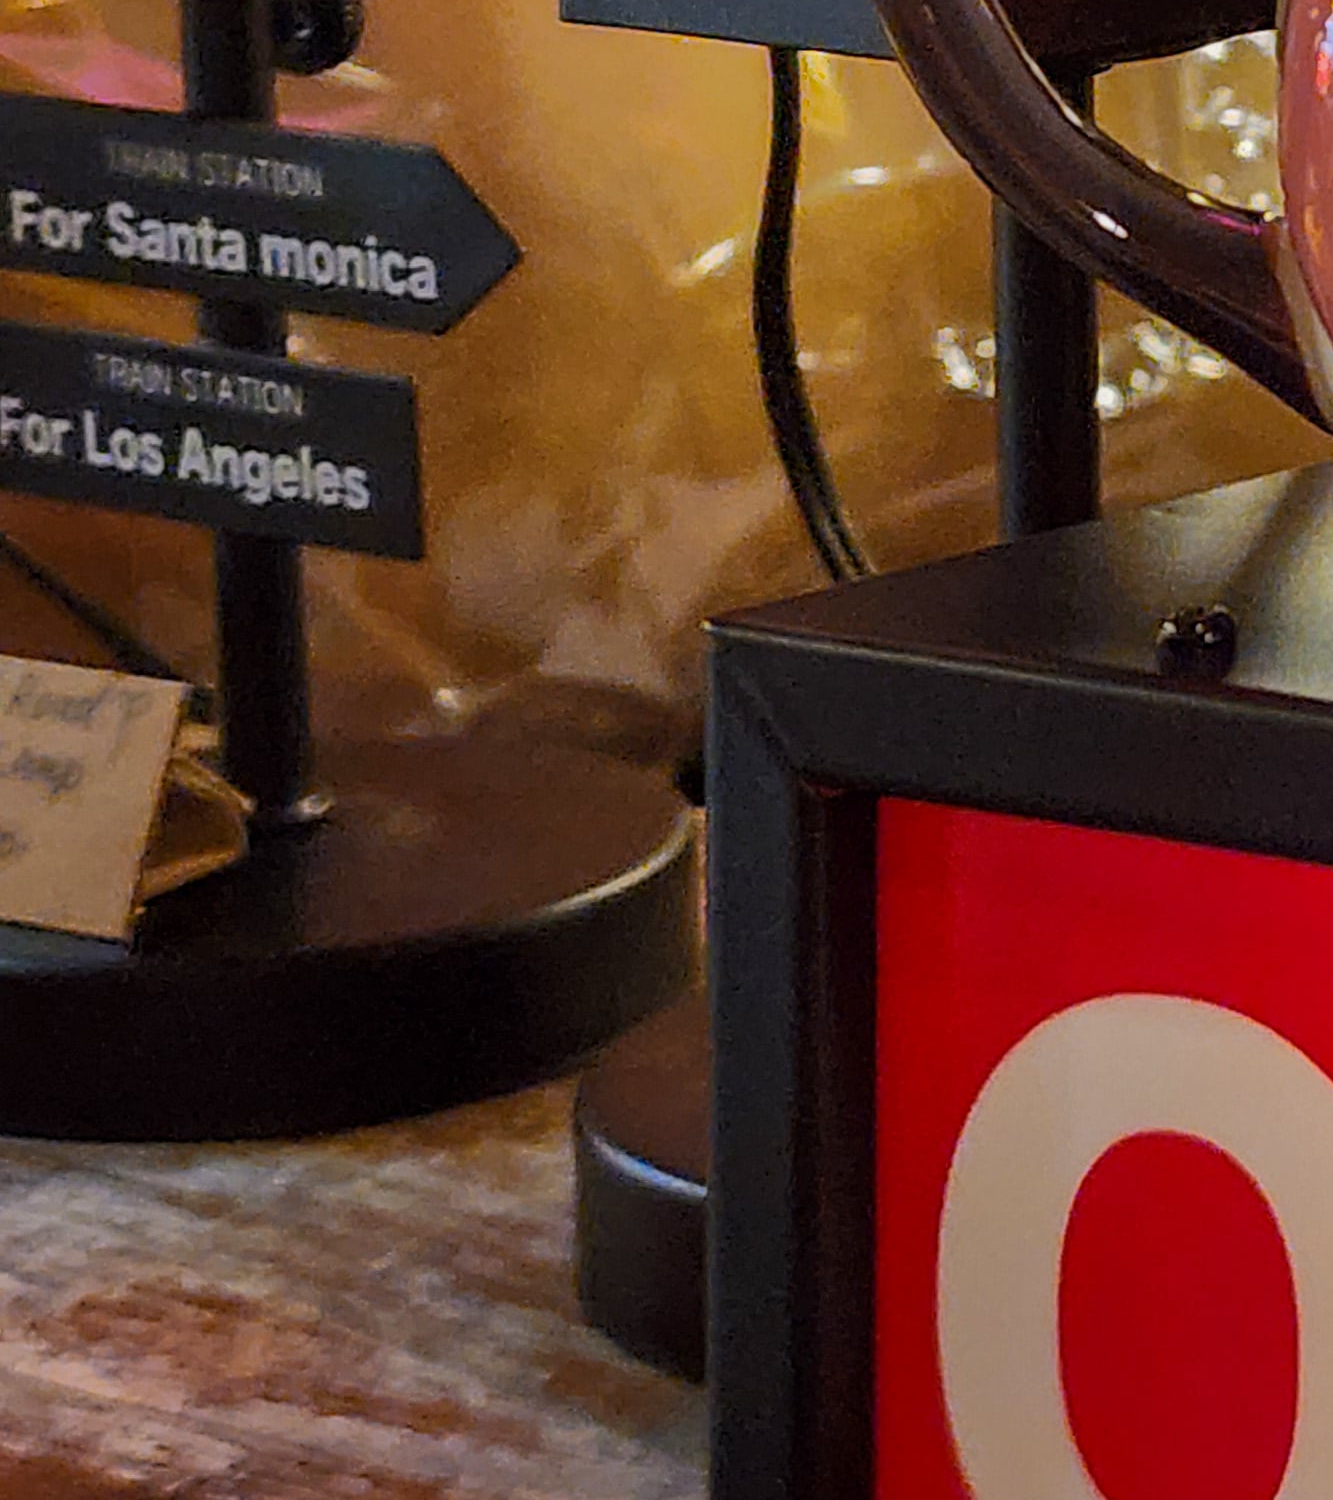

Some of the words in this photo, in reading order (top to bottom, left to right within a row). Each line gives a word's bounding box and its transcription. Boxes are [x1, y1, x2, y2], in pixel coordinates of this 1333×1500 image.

[201, 151, 324, 198] STATION
[10, 190, 92, 252] For
[105, 201, 247, 273] Santa
[259, 233, 439, 300] monica
[180, 367, 304, 417] STATION
[0, 396, 73, 457] For
[83, 408, 165, 477] Los
[177, 426, 372, 511] Angeles
